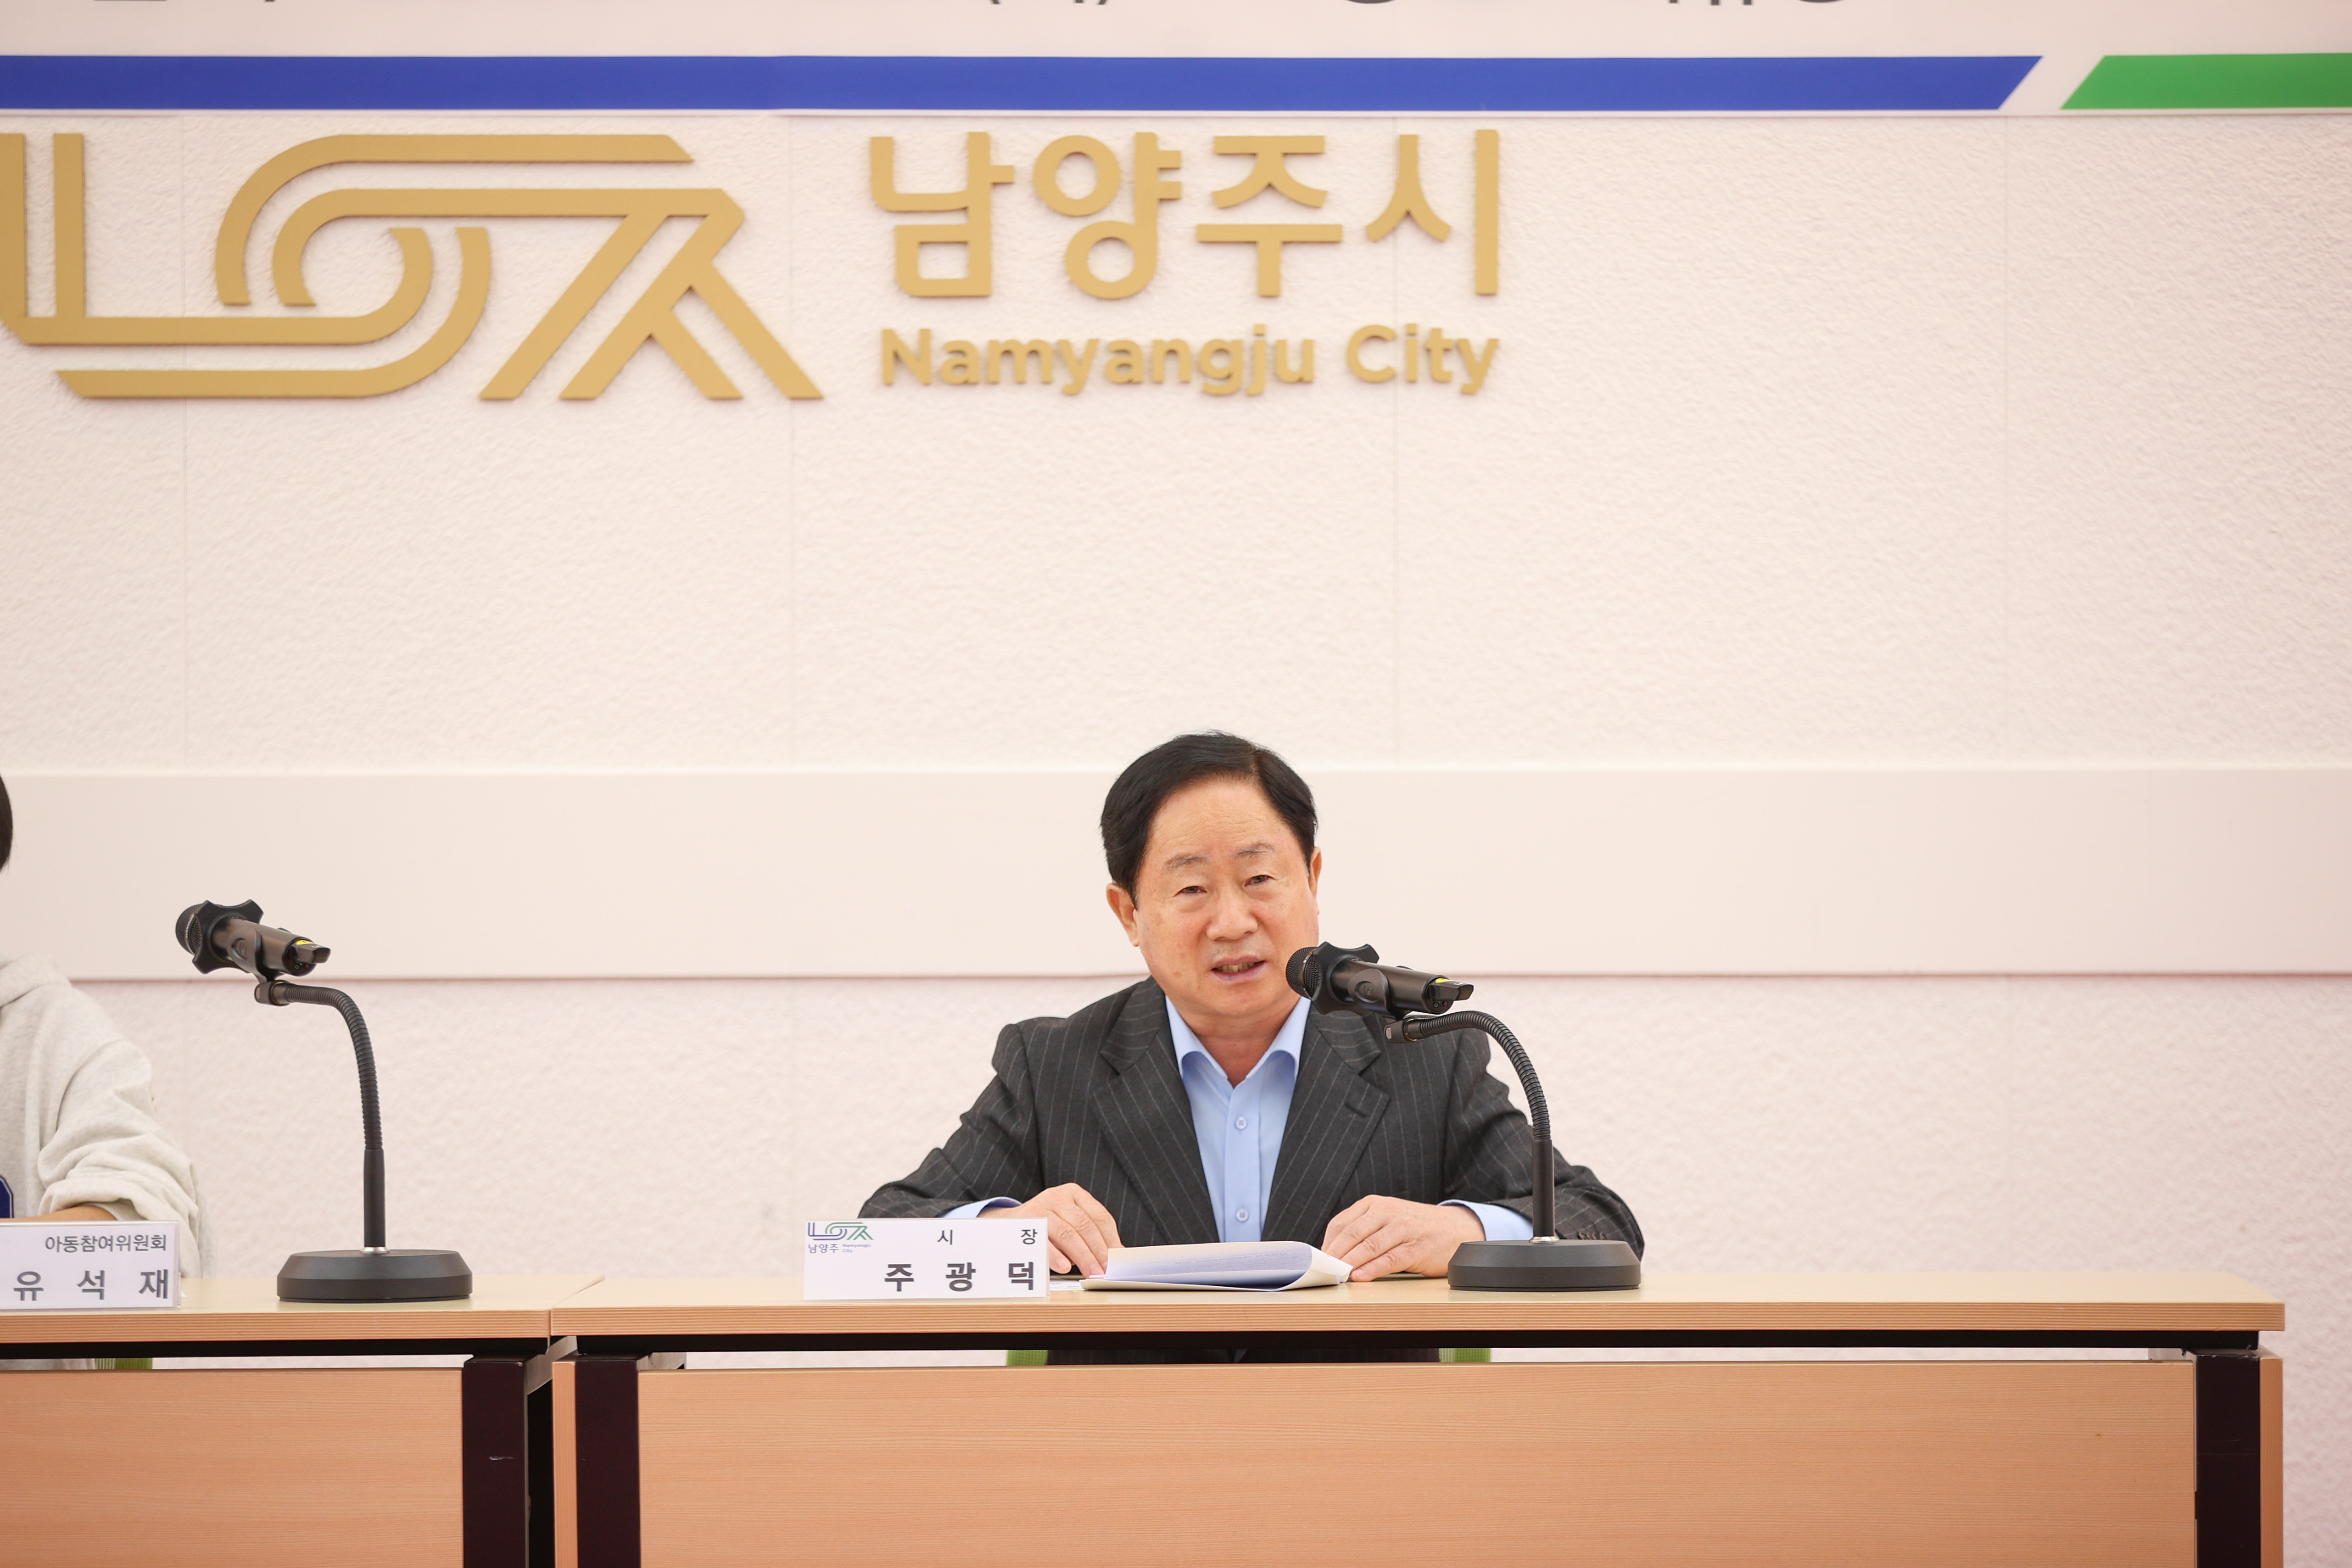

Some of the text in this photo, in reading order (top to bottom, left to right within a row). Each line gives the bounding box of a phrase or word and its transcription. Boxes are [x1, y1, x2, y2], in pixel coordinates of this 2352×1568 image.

[870, 130, 1499, 300] 남양주시
[882, 324, 1499, 396] Namyangju City
[45, 1234, 167, 1253] 아동참여위원회
[808, 1244, 839, 1254] 남양주
